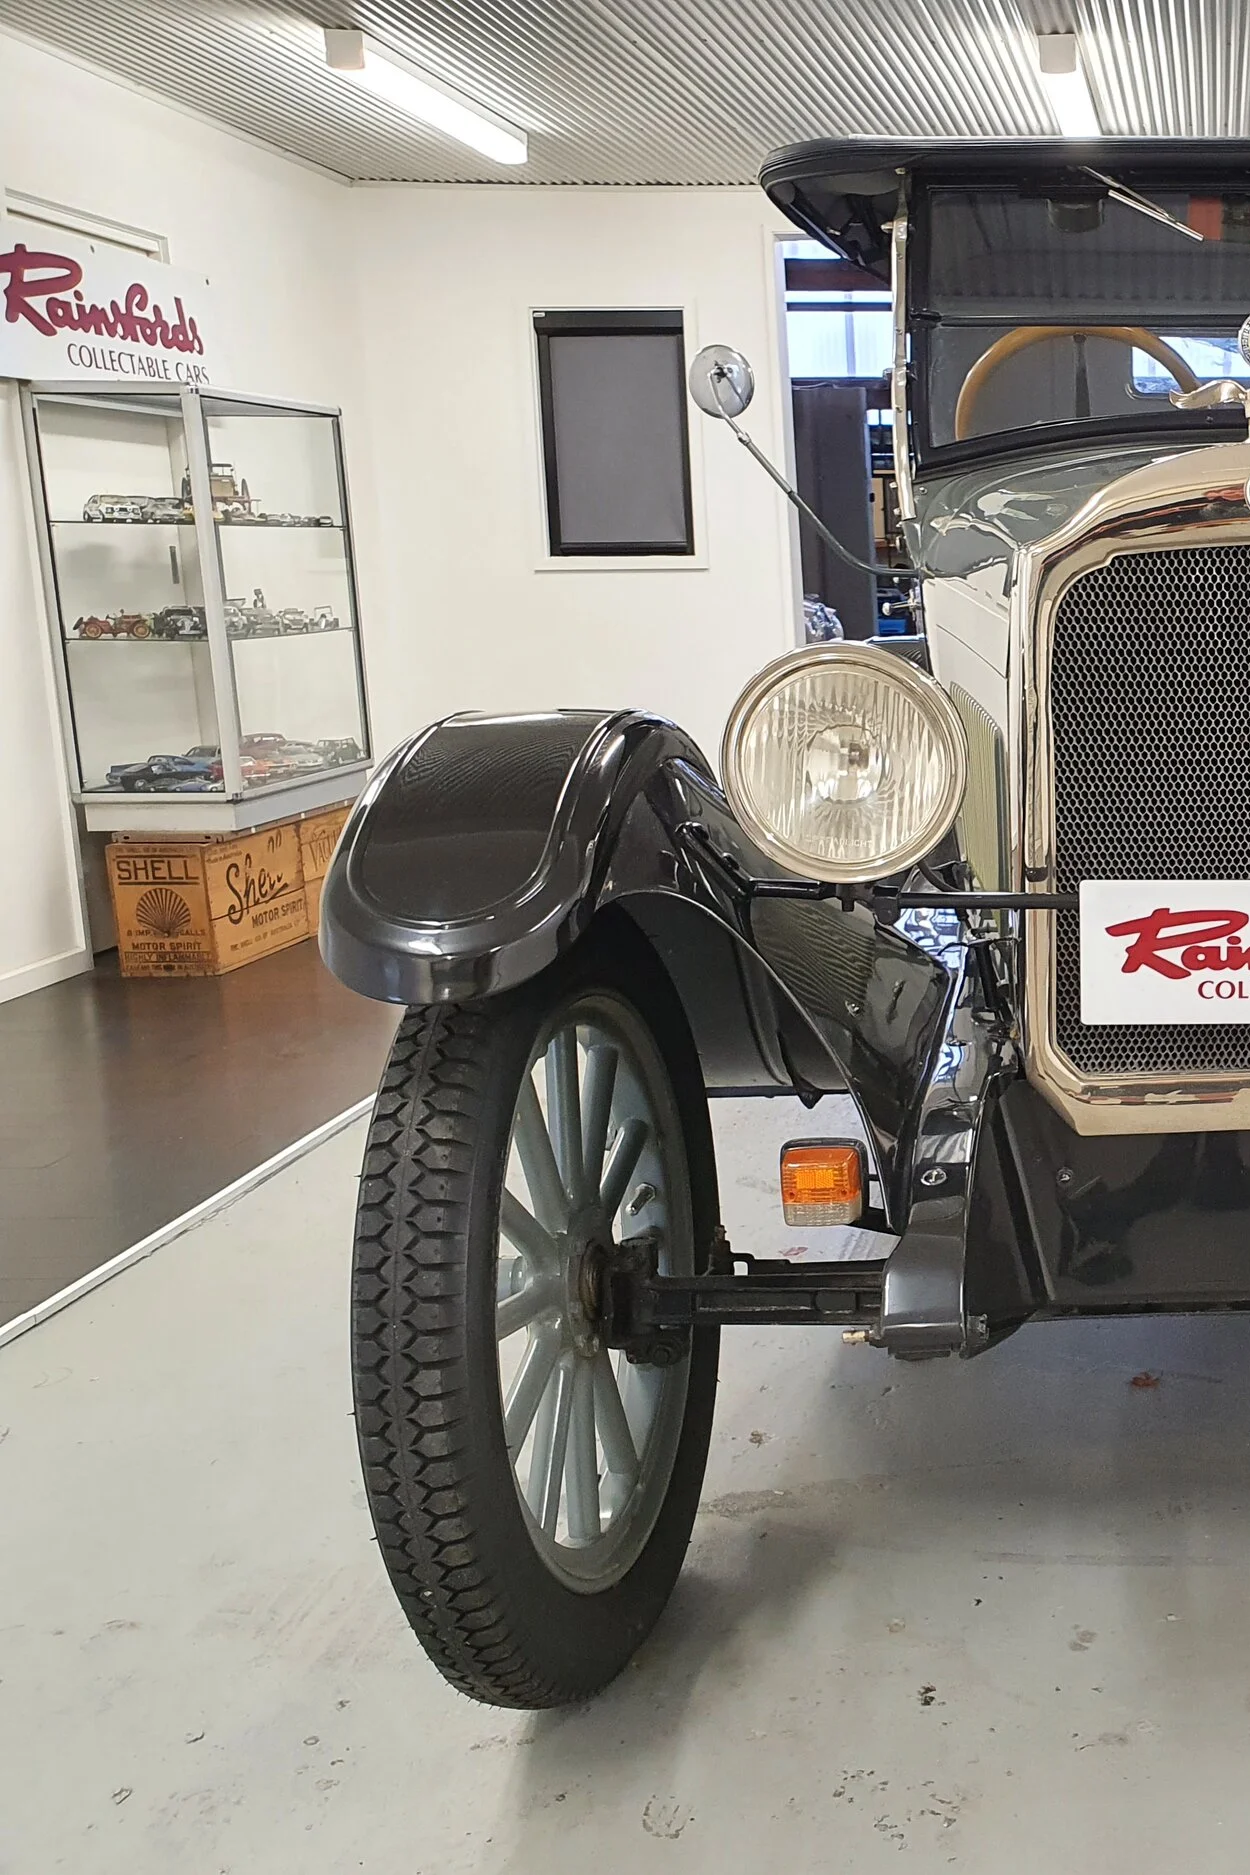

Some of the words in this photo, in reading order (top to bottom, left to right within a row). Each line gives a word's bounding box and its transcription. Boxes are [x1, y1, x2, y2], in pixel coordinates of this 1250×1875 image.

[0, 244, 204, 355] Rainsfords
[67, 343, 171, 380] COLLECTABLE
[175, 362, 210, 384] CARS
[116, 860, 199, 880] SHELL
[251, 907, 280, 928] MOTOR
[281, 899, 304, 916] SPIRIT
[132, 942, 165, 950] MOTOR
[170, 942, 202, 950] SPIRIT
